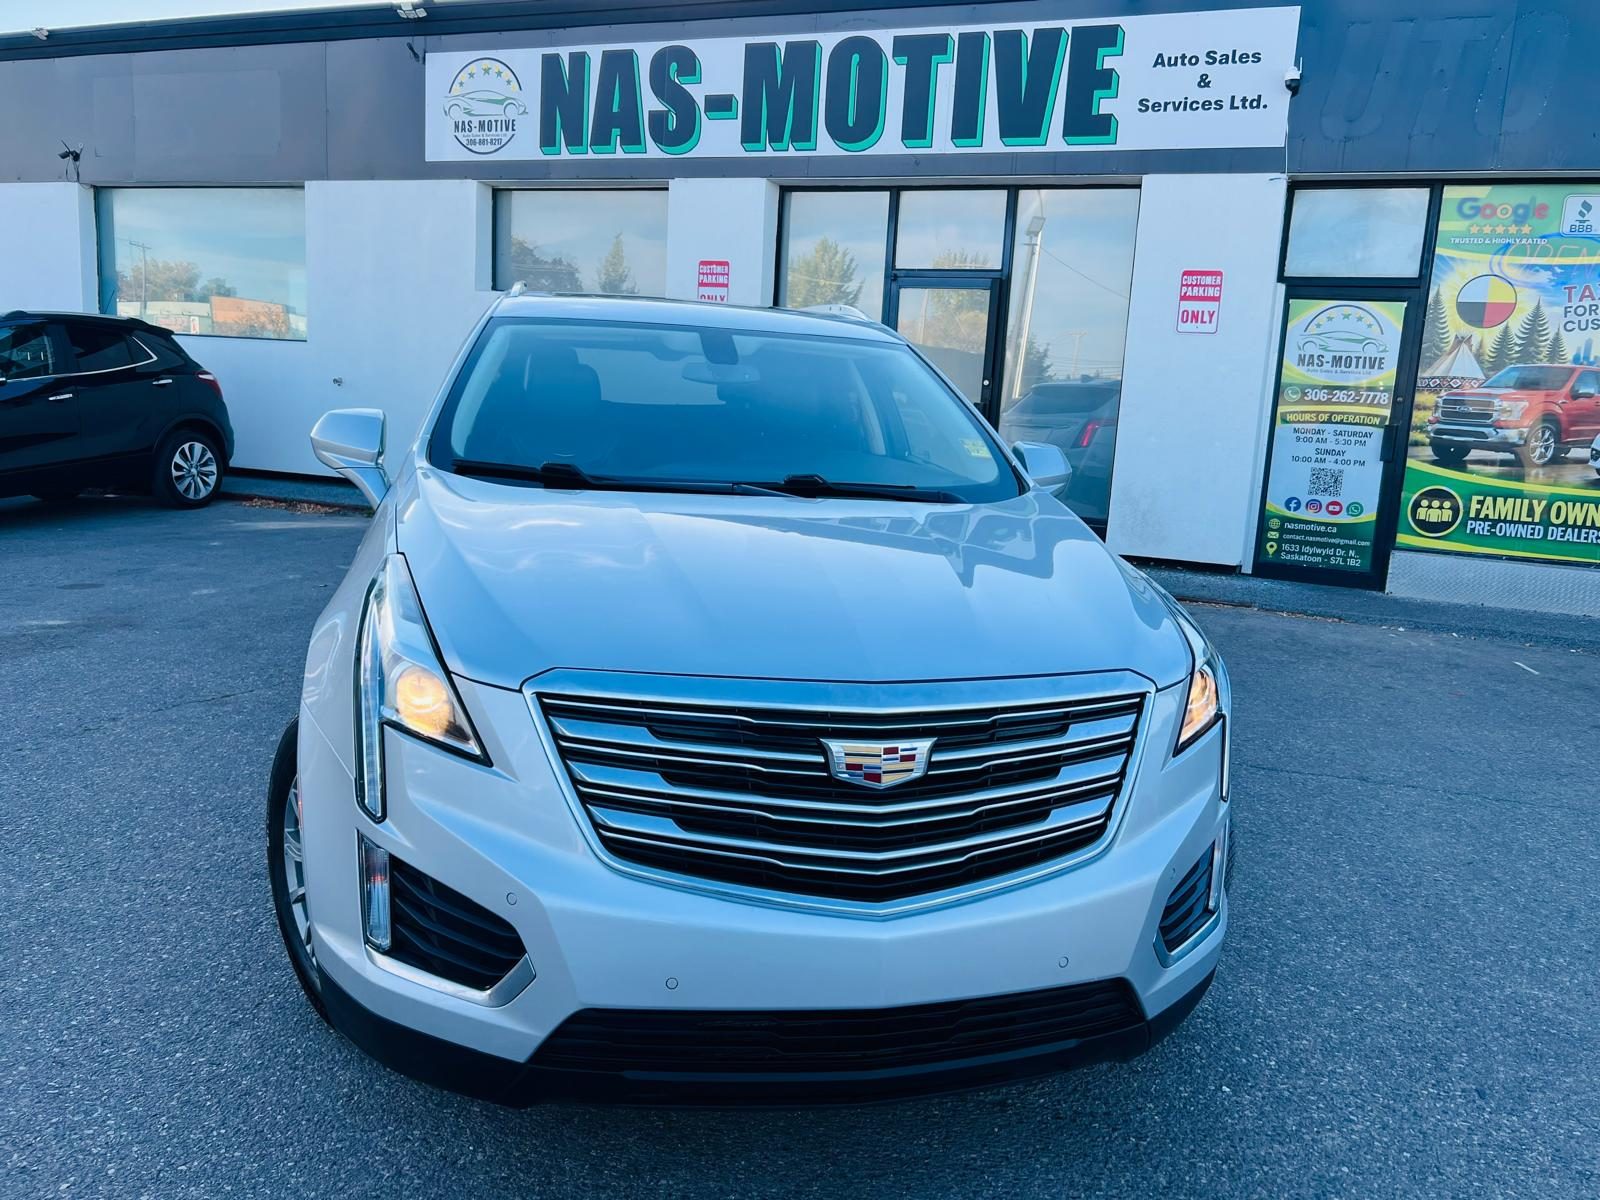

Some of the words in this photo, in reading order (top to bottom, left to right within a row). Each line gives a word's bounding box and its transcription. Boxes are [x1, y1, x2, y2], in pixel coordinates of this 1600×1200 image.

[1152, 53, 1200, 68] Auto
[1204, 49, 1262, 66] Sales
[1197, 73, 1211, 88] &
[540, 24, 1125, 155] NAS-MOTIVE
[1137, 96, 1224, 113] Services
[1229, 94, 1268, 110] Ltd.
[454, 119, 516, 133] NAS-MOTIVE
[1456, 195, 1549, 224] Google
[1570, 224, 1592, 232] BBB
[699, 274, 728, 284] PARKING
[1182, 276, 1221, 285] CUSTOMER
[1181, 286, 1220, 296] PARKING
[1564, 284, 1600, 303] TA
[1181, 310, 1216, 324] ONLY
[1564, 304, 1599, 318] FOR
[1564, 318, 1600, 332] CUS
[1297, 354, 1385, 370] NAS-MOTIVE
[1304, 389, 1389, 404] 306-262-7778
[1287, 413, 1316, 422] HOURS
[1318, 414, 1330, 422] OF
[1332, 414, 1380, 424] OPERATION
[1293, 427, 1326, 436] MONDAY
[1333, 430, 1373, 439] SATURDAY
[1315, 448, 1346, 456] SUNDAY
[1469, 495, 1547, 523] FAMILY
[1550, 501, 1600, 527] OWN
[1284, 522, 1337, 533] nasmotive.ca
[1466, 520, 1544, 539] PRE-OWNED
[1283, 533, 1370, 546] contact.nasmotive@gmail.com
[1282, 544, 1300, 552] 1633
[1302, 545, 1334, 555] Idylwyld
[1281, 552, 1322, 562] Saskatoon
[1330, 556, 1344, 565] S7L
[1346, 558, 1361, 566] 1B2
